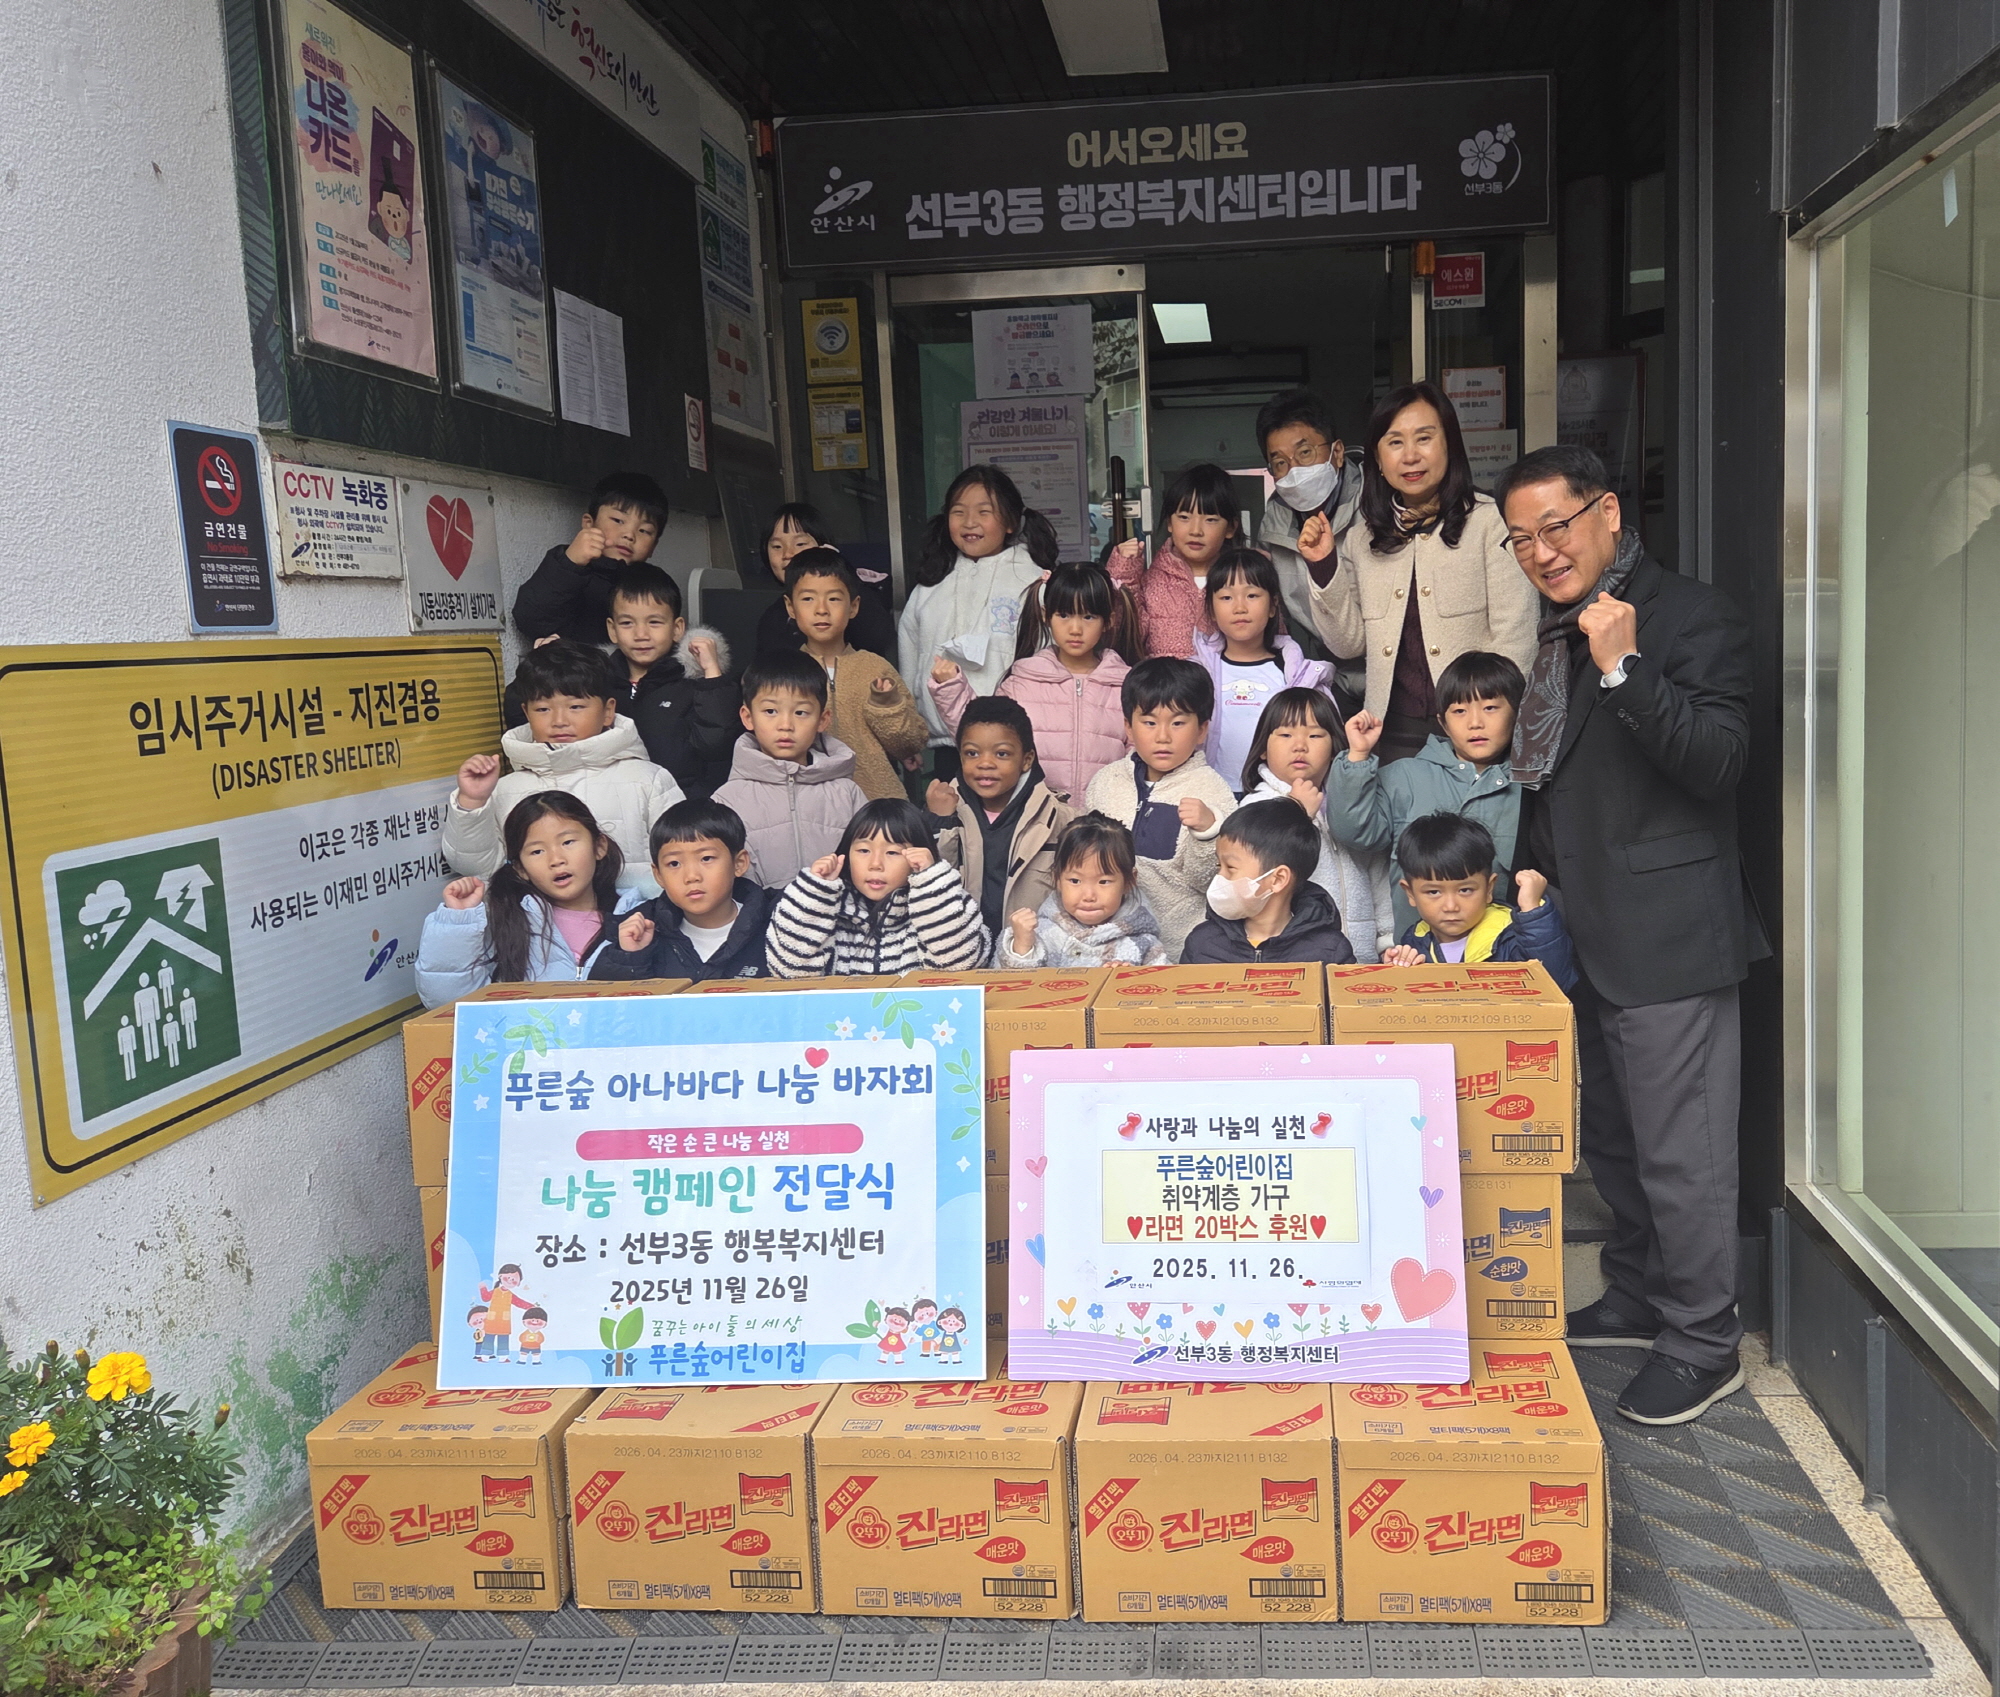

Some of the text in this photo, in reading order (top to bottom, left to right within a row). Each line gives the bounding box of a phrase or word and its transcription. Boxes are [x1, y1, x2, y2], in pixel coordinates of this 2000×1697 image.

[304, 69, 349, 128] 다온
[1067, 121, 1248, 168] 어서오세요
[1464, 181, 1504, 196] 선부3동
[906, 164, 1422, 240] 선부3동 행정복지센터입니다
[810, 213, 876, 234] 안산시
[1441, 266, 1474, 282] 에스원
[1434, 298, 1462, 308] SECOM
[1018, 405, 1069, 423] 겨울나기
[283, 470, 388, 511] CCTV 녹화중
[203, 521, 248, 540] 금연건물
[207, 541, 249, 557] No Smoking
[419, 592, 497, 621] 자동심장충격기 설치기관
[129, 679, 441, 758] 임시주거시설 지진겸용
[212, 737, 402, 800] (DISASTER SHELTER)
[299, 804, 440, 862] 이곳은 각종 재난 발생
[250, 890, 318, 932] 사용되는
[323, 872, 369, 910] 이재민
[414, 1059, 447, 1096] 멀티팩
[504, 1063, 934, 1112] 푸른숲 아나바다 나눔 바자회
[1495, 1099, 1529, 1116] 매운맛
[1145, 1114, 1306, 1142] 사랑과 나눔의 실천
[647, 1130, 790, 1153] 작은 손 큰 나눔 실천
[1156, 1153, 1293, 1182] 푸른숲어린이집
[1505, 1157, 1550, 1166] 52 228
[541, 1162, 895, 1219] 나눔 캠페인 전달식
[1162, 1183, 1290, 1212] 취약계층 가구
[1145, 1213, 1308, 1242] 라면 20박스 후원
[535, 1235, 587, 1269] 장소
[619, 1229, 714, 1265] 선부3동
[724, 1228, 886, 1263] 행복복지센터
[1153, 1257, 1305, 1280] 2025. 11. 26.
[1489, 1260, 1522, 1279] 순한맛
[610, 1275, 809, 1307] 2025년 11월 26일
[1500, 1322, 1544, 1331] 52 225
[648, 1341, 807, 1378] 푸른숲어린이집
[1173, 1344, 1339, 1365] 선부3동 행정복지센터
[860, 1392, 900, 1402] 오뚜기
[912, 1382, 1048, 1409] 진라면
[1360, 1392, 1400, 1403] 오뚜기
[1415, 1380, 1551, 1411] 진라면
[1005, 1403, 1043, 1414] 매운맛
[1524, 1403, 1560, 1414] 매운맛
[324, 1479, 355, 1514] 멀티팩
[578, 1474, 611, 1510] 멀티팩
[828, 1479, 863, 1516] 멀티팩
[1087, 1481, 1125, 1520] 멀티팩
[1351, 1482, 1389, 1521] 멀티팩
[350, 1523, 378, 1536] 오뚜기
[389, 1503, 478, 1546] 진라면
[604, 1520, 633, 1532] 오뚜기
[645, 1501, 736, 1544] 진라면
[855, 1526, 885, 1539] 오뚜기
[896, 1507, 990, 1551] 진라면
[1159, 1507, 1257, 1553] 진라면
[1424, 1510, 1525, 1556] 진라면
[475, 1535, 508, 1553] 매운맛
[732, 1533, 764, 1551] 매운맛
[1115, 1529, 1146, 1542] 오뚜기
[1380, 1531, 1410, 1543] 오뚜기
[985, 1541, 1020, 1558] 매운맛
[1252, 1542, 1287, 1559] 매운맛
[1519, 1545, 1555, 1563] 매운맛
[489, 1595, 533, 1603] 52 228
[744, 1594, 790, 1603] 52 228
[997, 1602, 1044, 1612] 52 228
[1264, 1603, 1312, 1612] 52 228
[1529, 1608, 1579, 1617] 52 228
